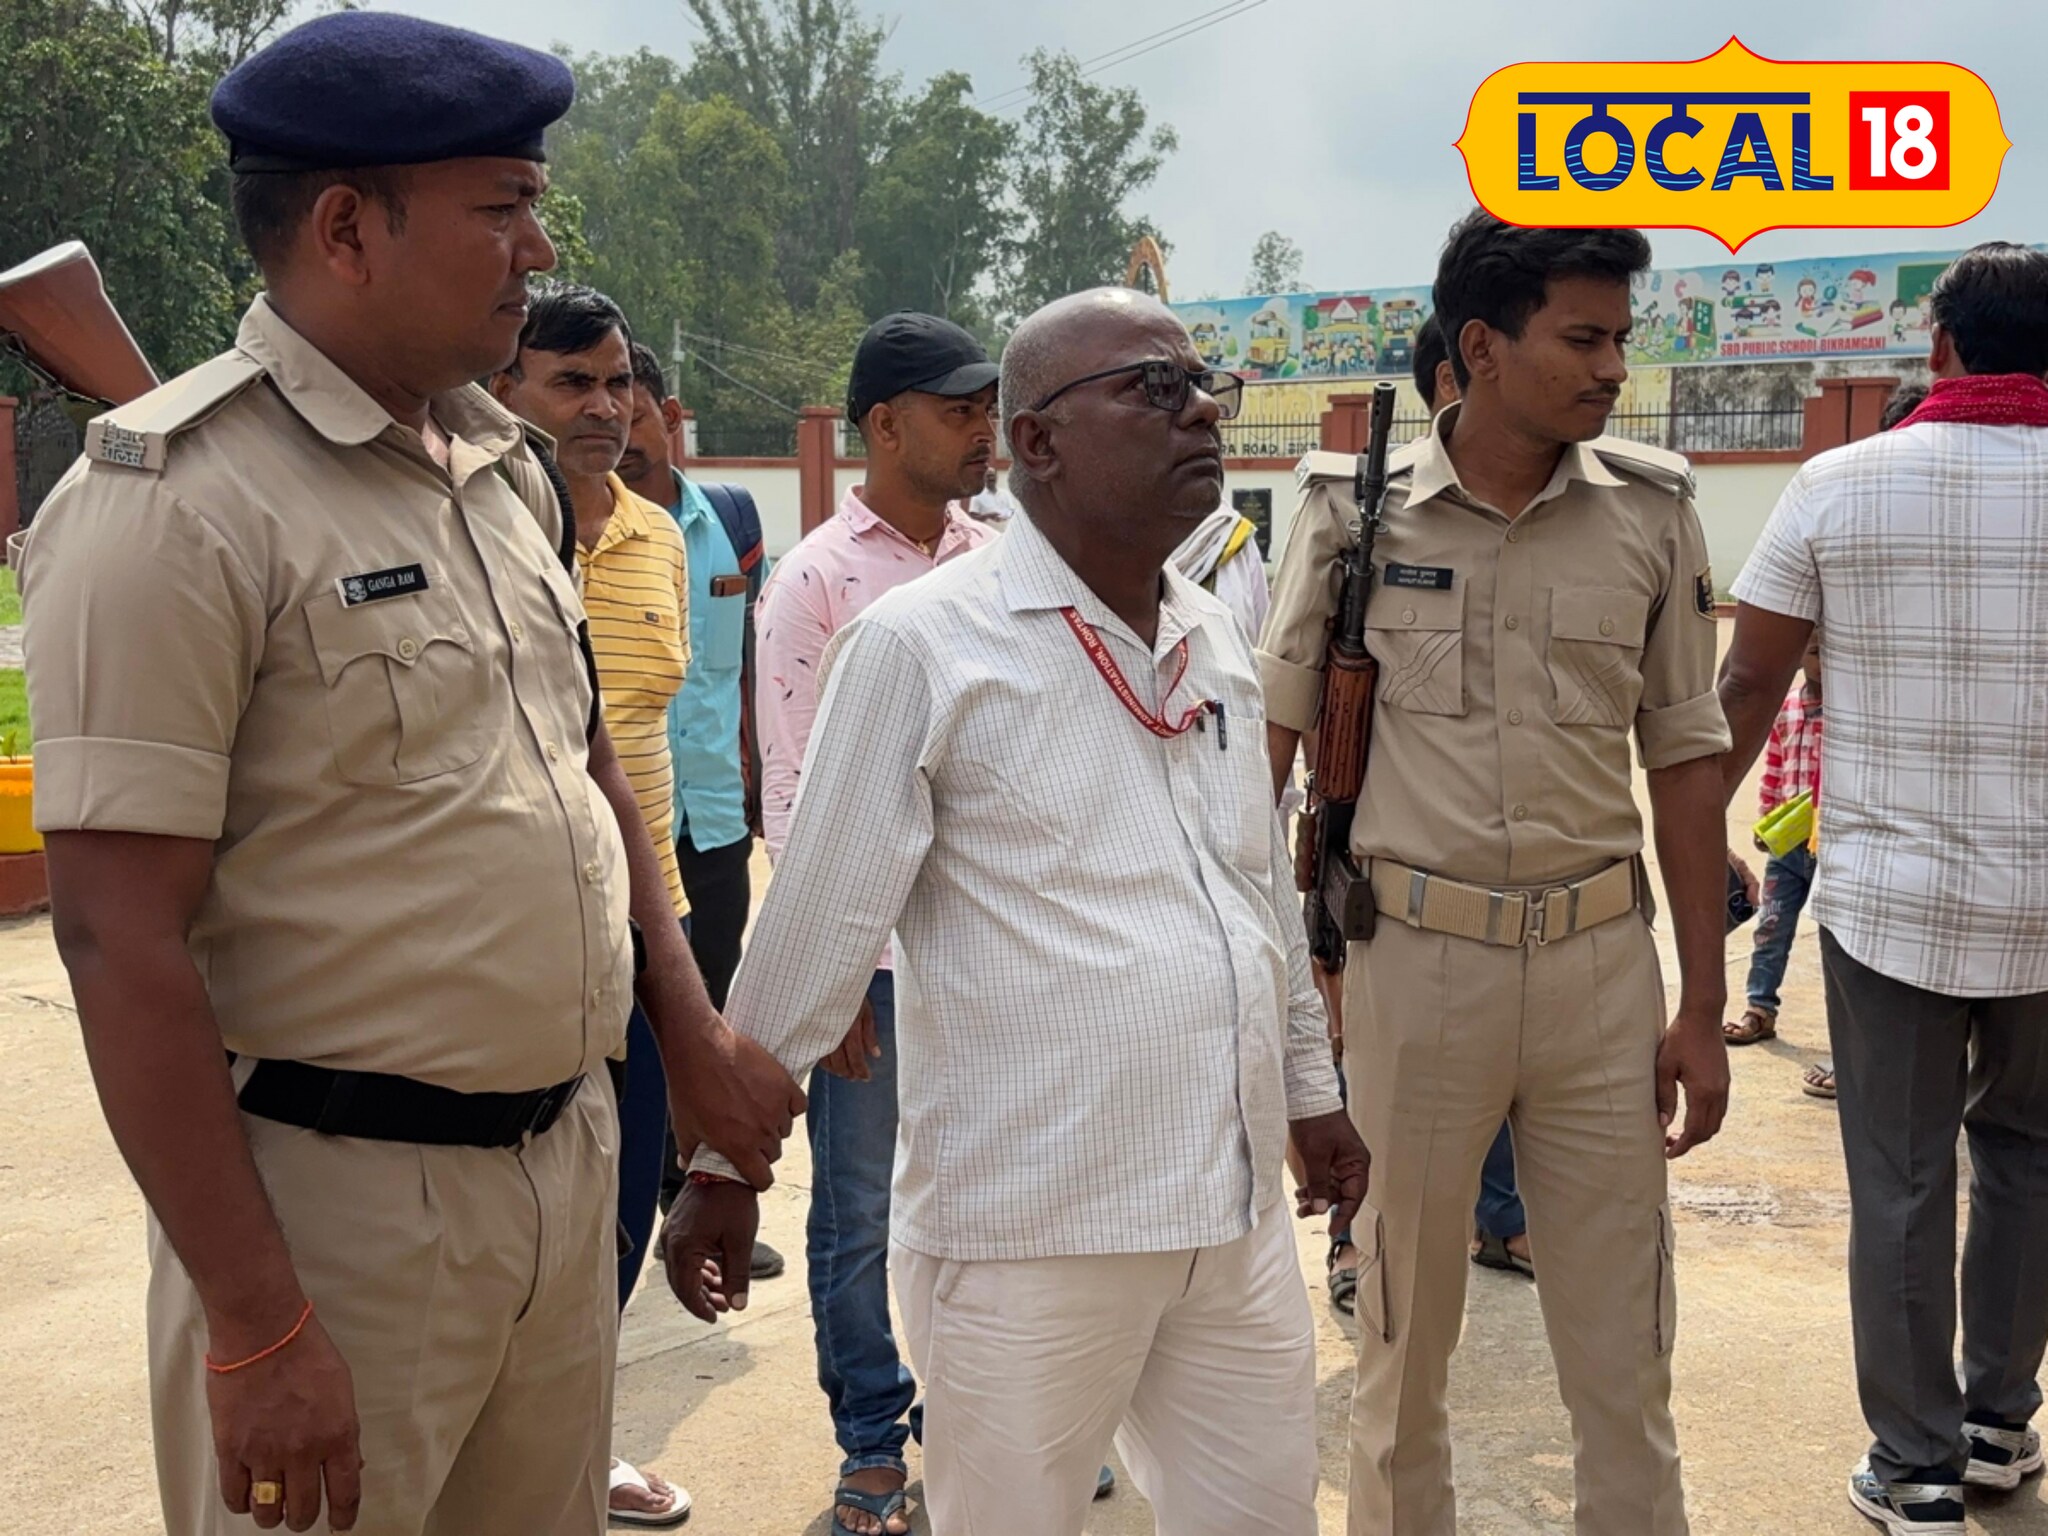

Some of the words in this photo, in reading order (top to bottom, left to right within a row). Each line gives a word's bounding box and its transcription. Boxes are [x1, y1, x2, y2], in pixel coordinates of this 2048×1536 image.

[1720, 342, 1741, 357] SBD
[1742, 340, 1777, 356] PUBLIC
[1779, 338, 1816, 354] SCHOOL
[367, 575, 396, 592] GANGA
[397, 571, 416, 587] RAM
[1069, 612, 1099, 649] ROHTAS
[1095, 646, 1154, 726] ADMINISTRATION,
